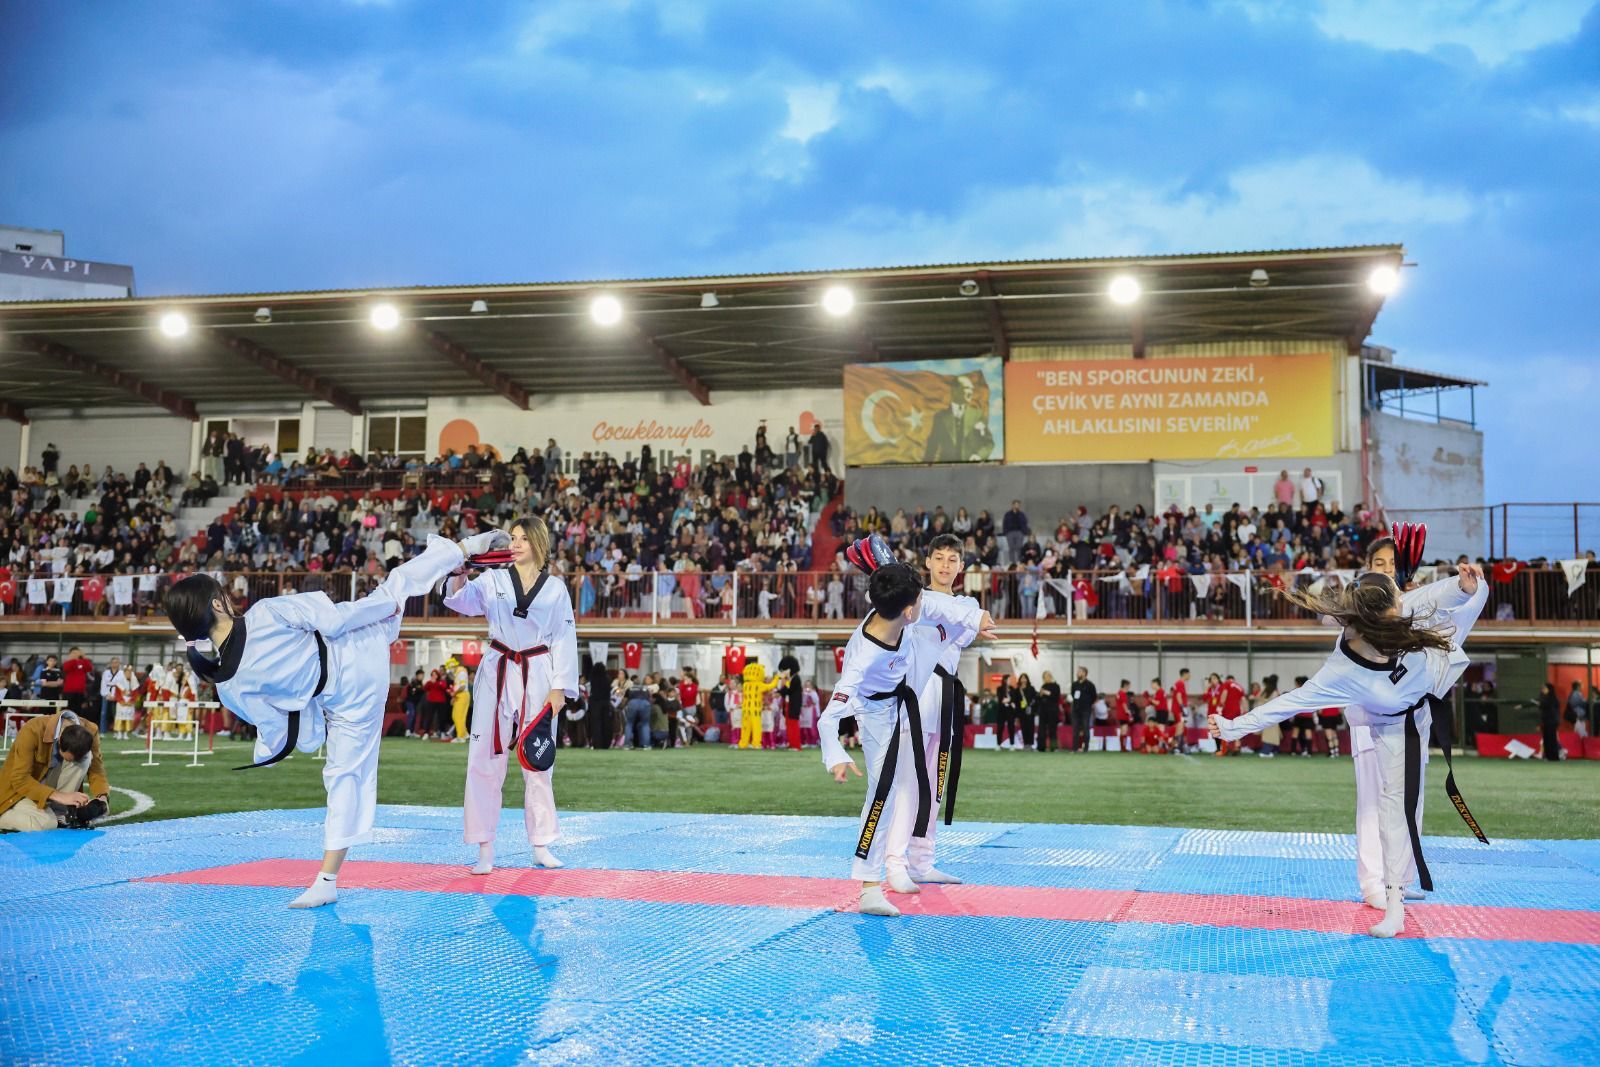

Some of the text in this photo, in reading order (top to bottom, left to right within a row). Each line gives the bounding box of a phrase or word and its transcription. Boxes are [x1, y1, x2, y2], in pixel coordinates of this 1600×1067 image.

[21, 255, 91, 275] YAPI
[1036, 370, 1083, 387] "BEN
[1088, 367, 1207, 386] SPORCUNUN
[1212, 362, 1255, 382] ZEKİ
[1032, 391, 1269, 415] ÇEVİK VE AYNI ZAMANDA
[1043, 414, 1259, 435] AHLAKLISINI SEVERİM"
